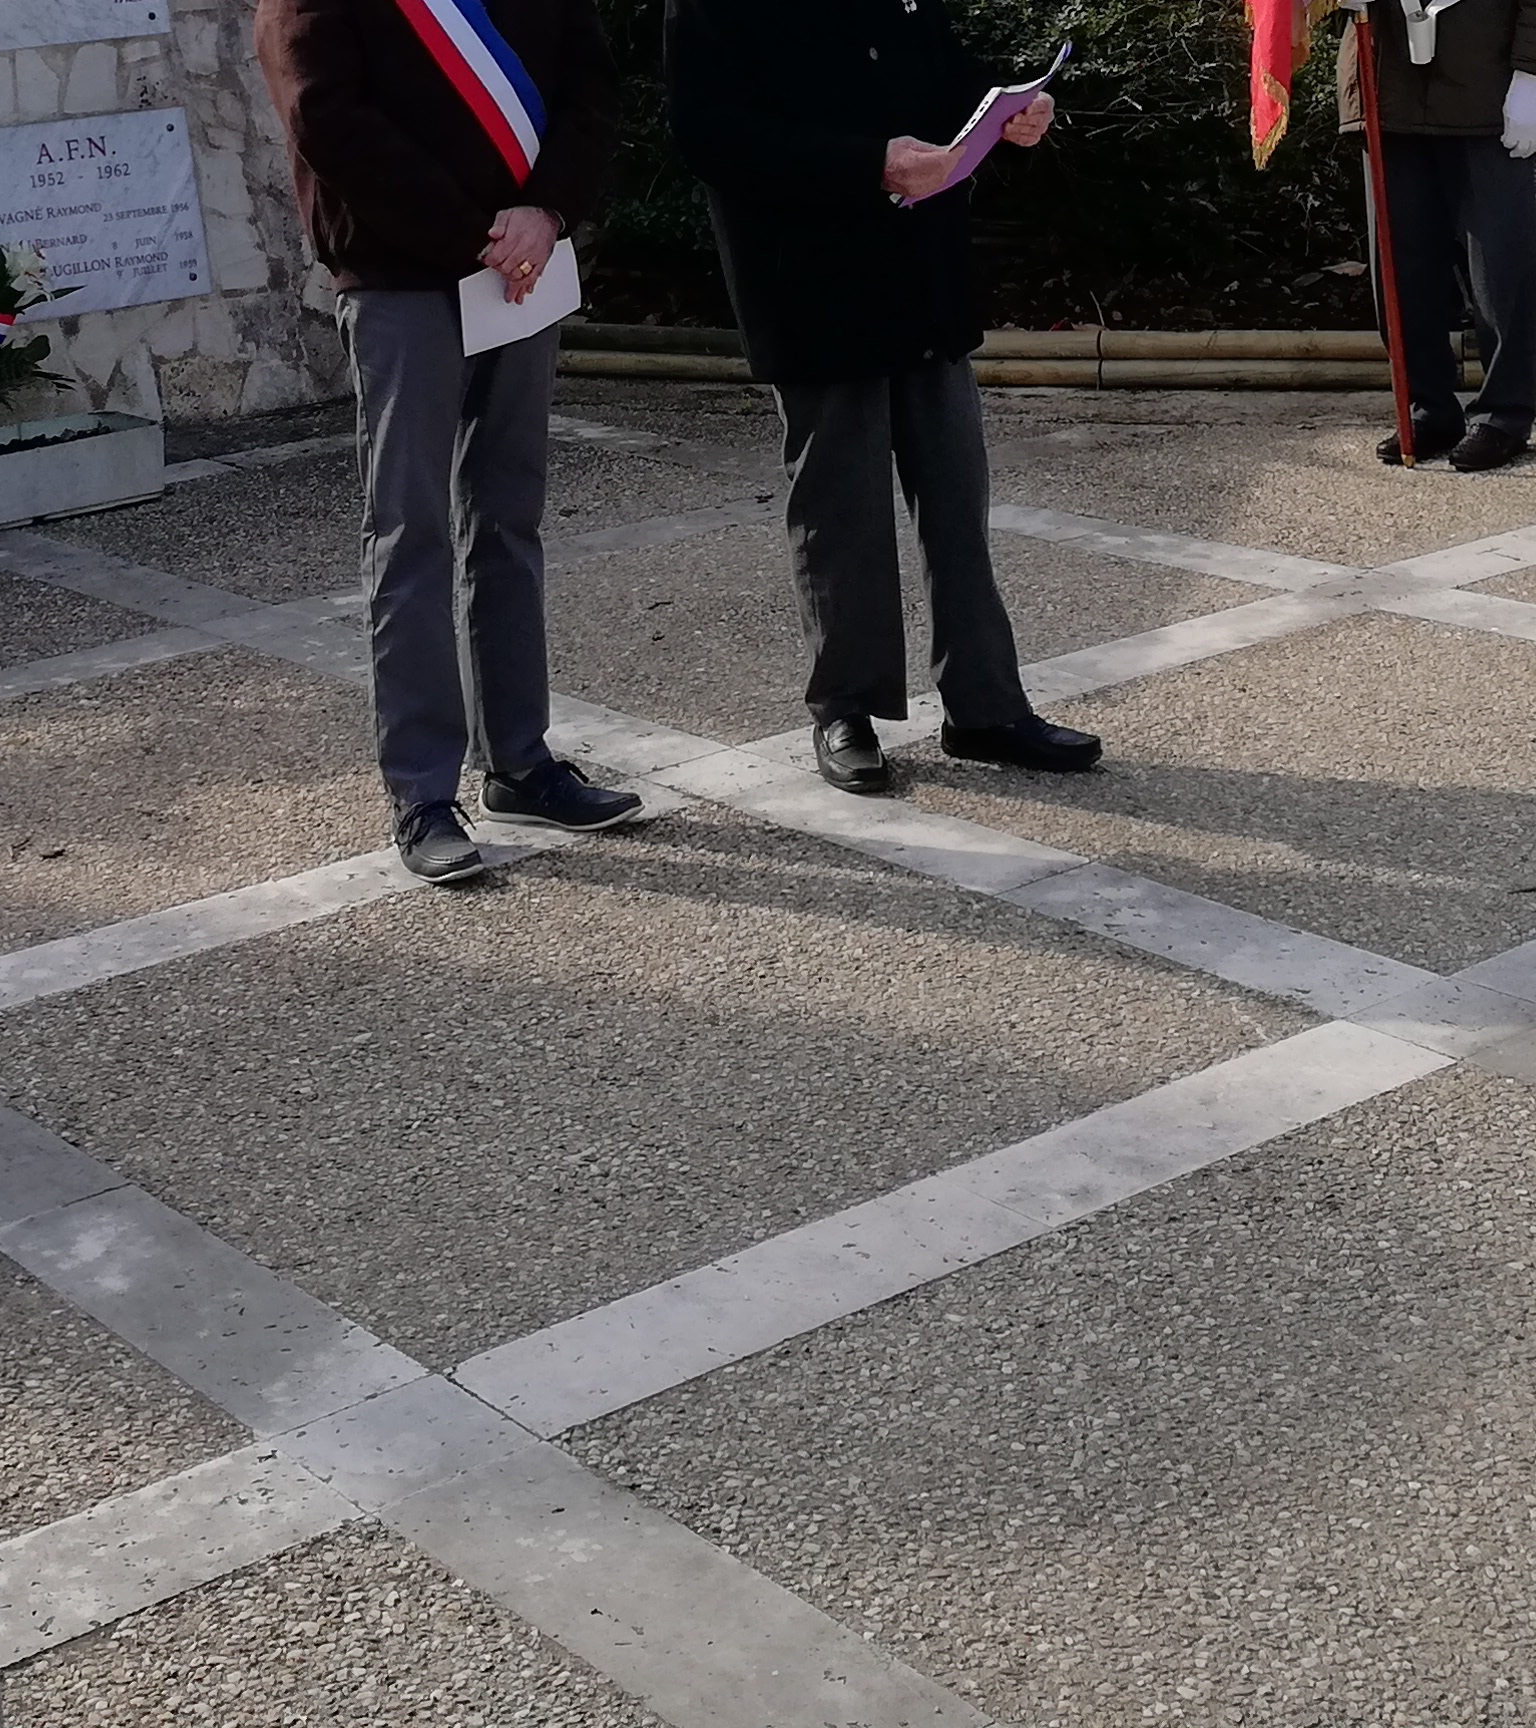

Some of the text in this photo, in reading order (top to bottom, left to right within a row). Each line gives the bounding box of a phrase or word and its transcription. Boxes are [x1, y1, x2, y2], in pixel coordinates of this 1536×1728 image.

[36, 135, 117, 165] A.F.N.
[30, 171, 65, 189] 1952
[97, 162, 131, 180] 1962
[47, 202, 103, 220] RAYMOND
[115, 205, 167, 221] SEPTEMBRE
[135, 236, 157, 250] JUIN
[50, 252, 169, 278] UGILLON RAYMOND
